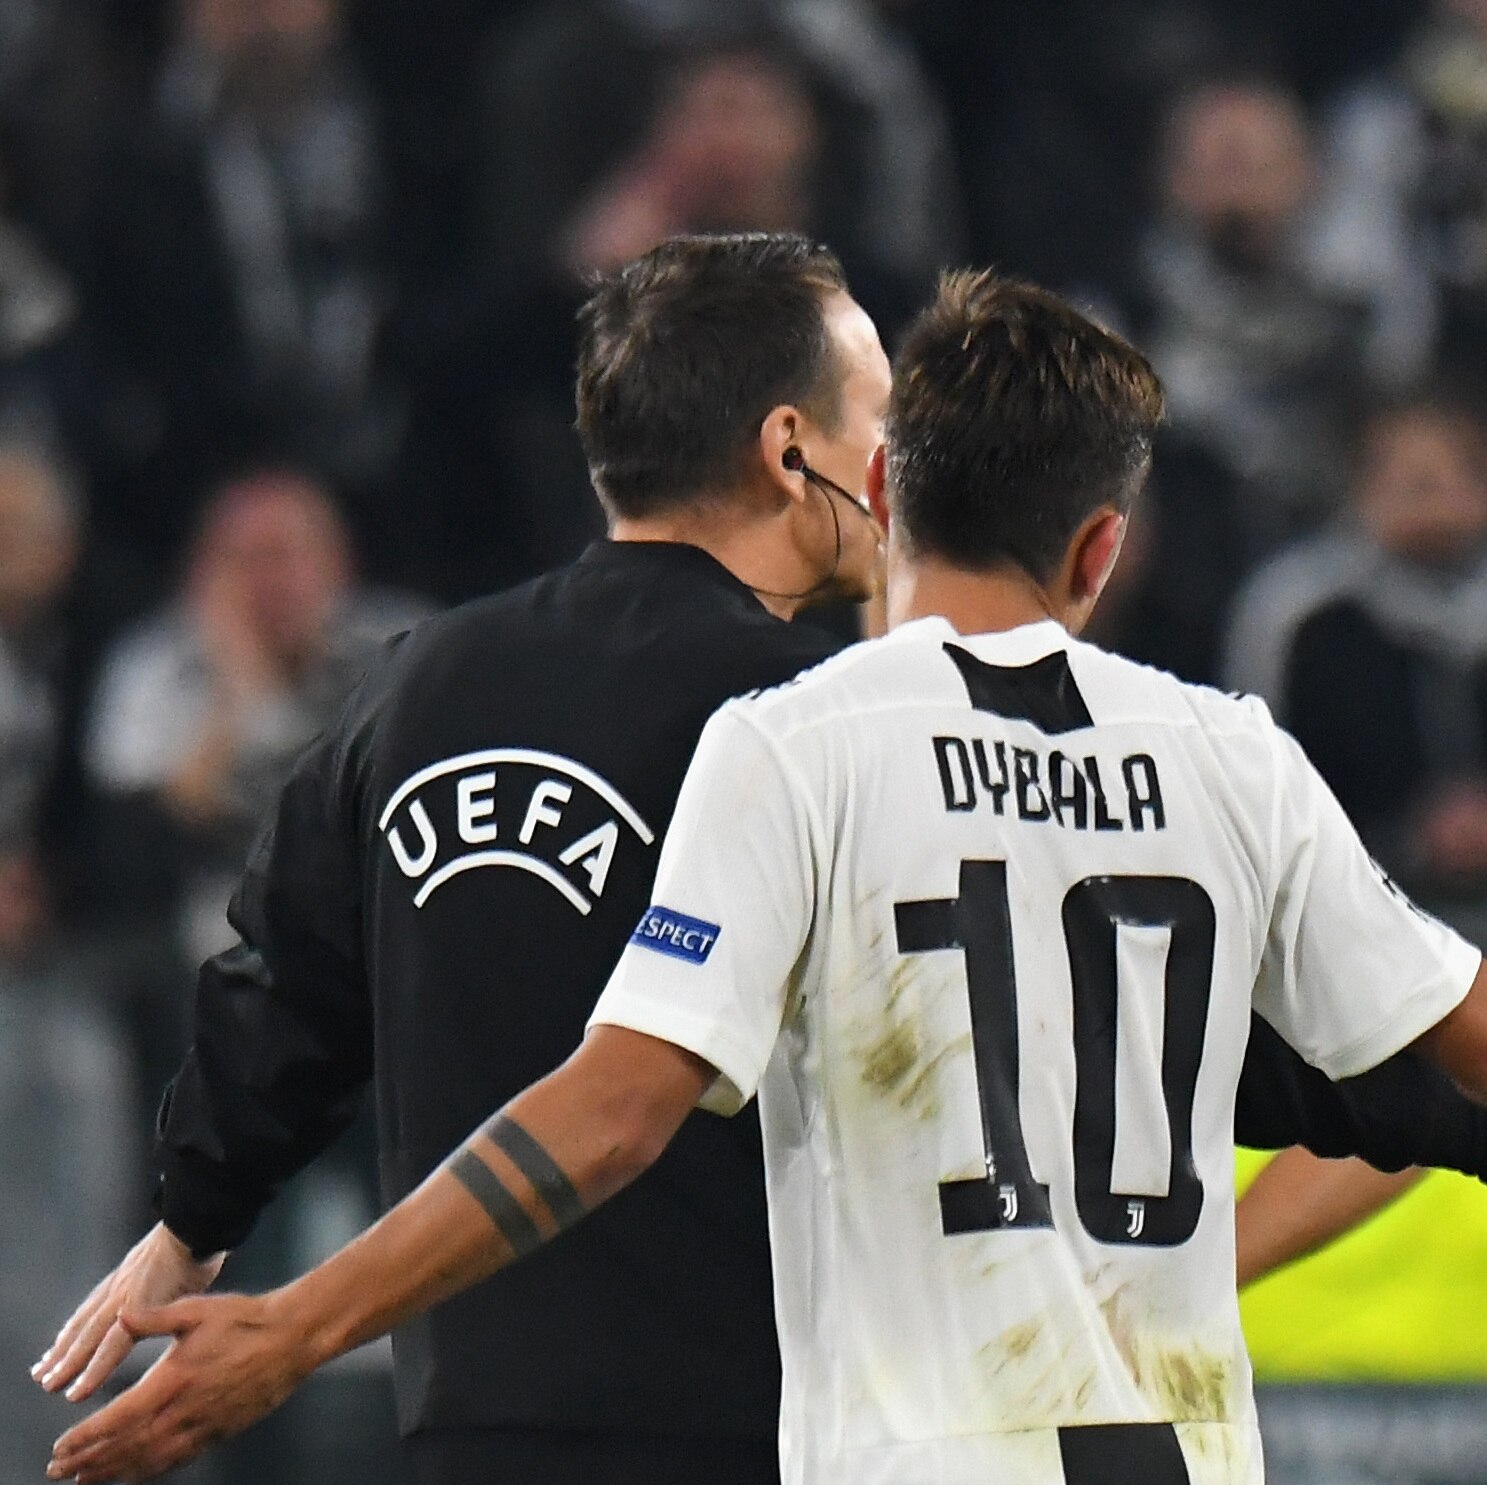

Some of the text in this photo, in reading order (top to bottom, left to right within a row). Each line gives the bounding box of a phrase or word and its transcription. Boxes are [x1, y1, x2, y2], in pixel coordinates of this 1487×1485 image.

[386, 770, 620, 898] UEFA
[931, 735, 1168, 833] DYBALA
[893, 858, 1217, 1248] 10
